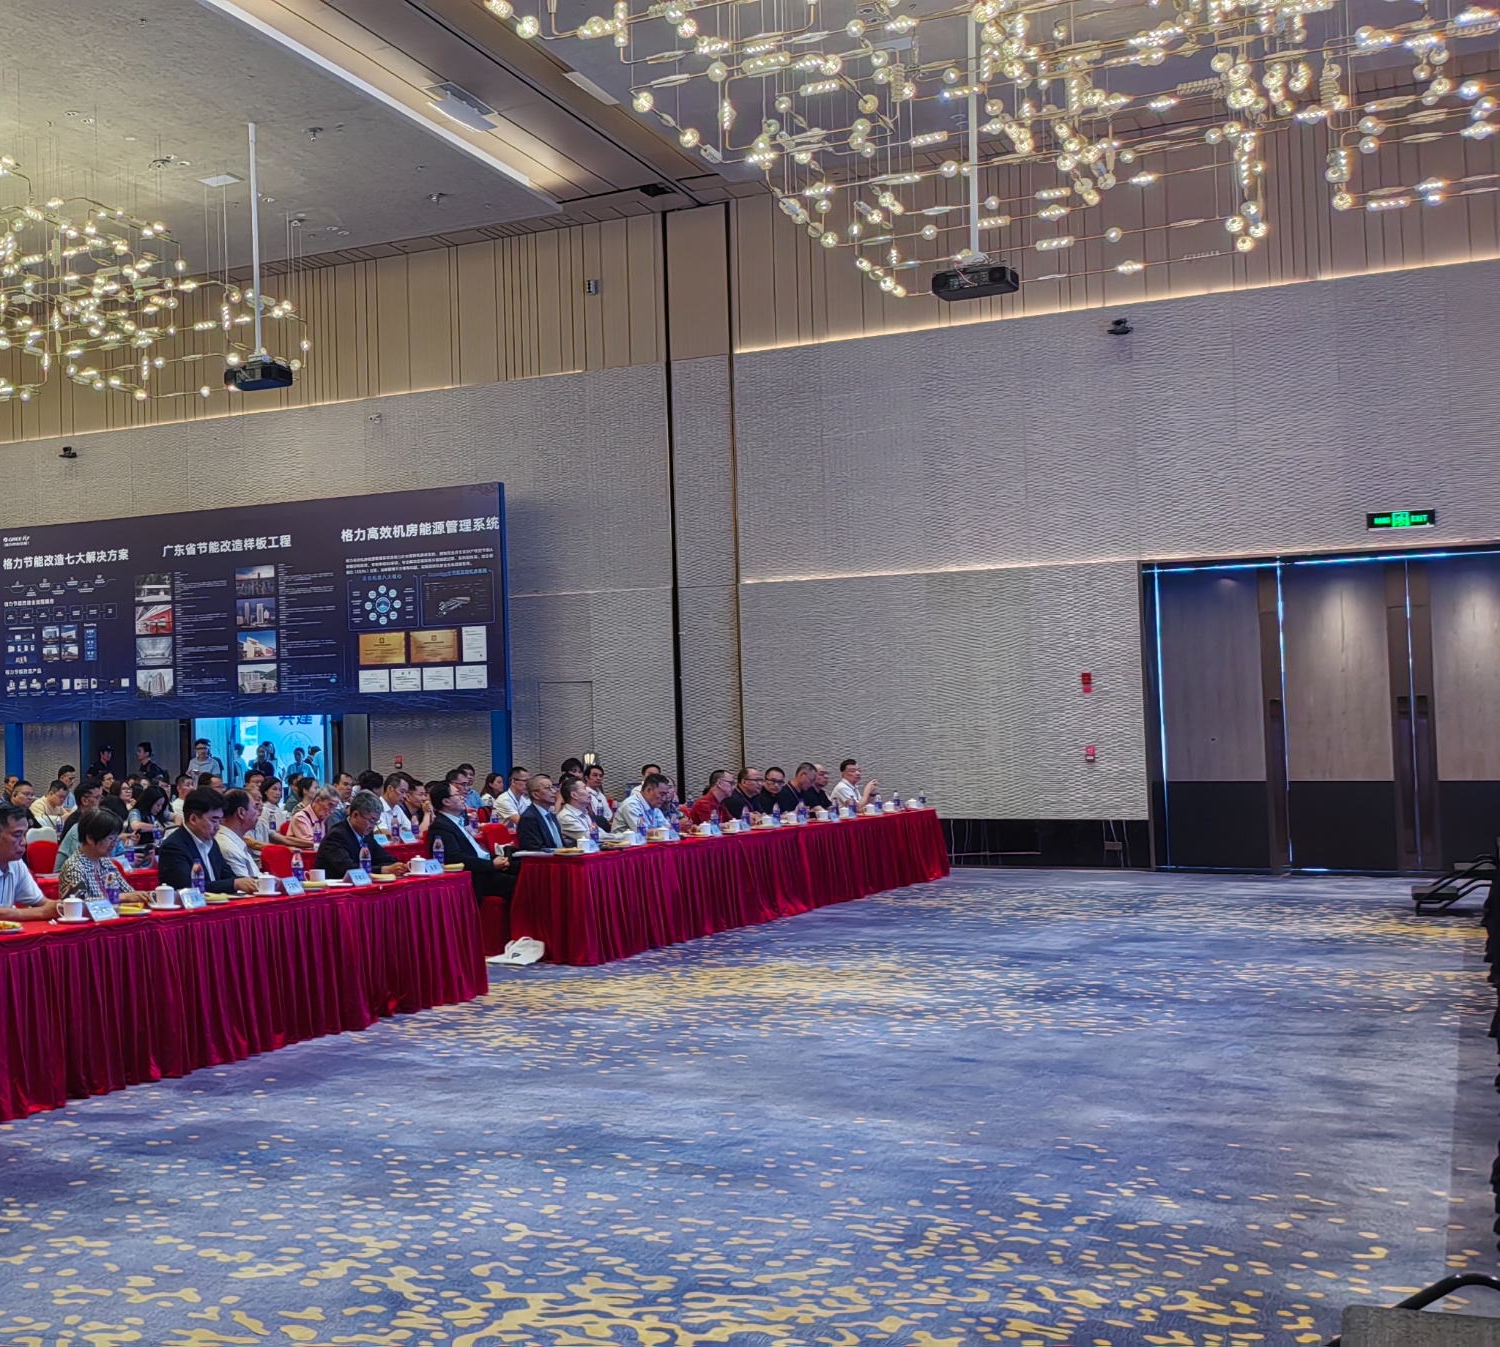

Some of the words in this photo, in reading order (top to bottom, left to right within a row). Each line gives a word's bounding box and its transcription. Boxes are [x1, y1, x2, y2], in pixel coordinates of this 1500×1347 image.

[340, 516, 500, 542] 格力高效机房能源管理系统
[162, 534, 292, 557] 广东省节能改造样板工程
[3, 548, 129, 570] 格力节能改造七大解决方案
